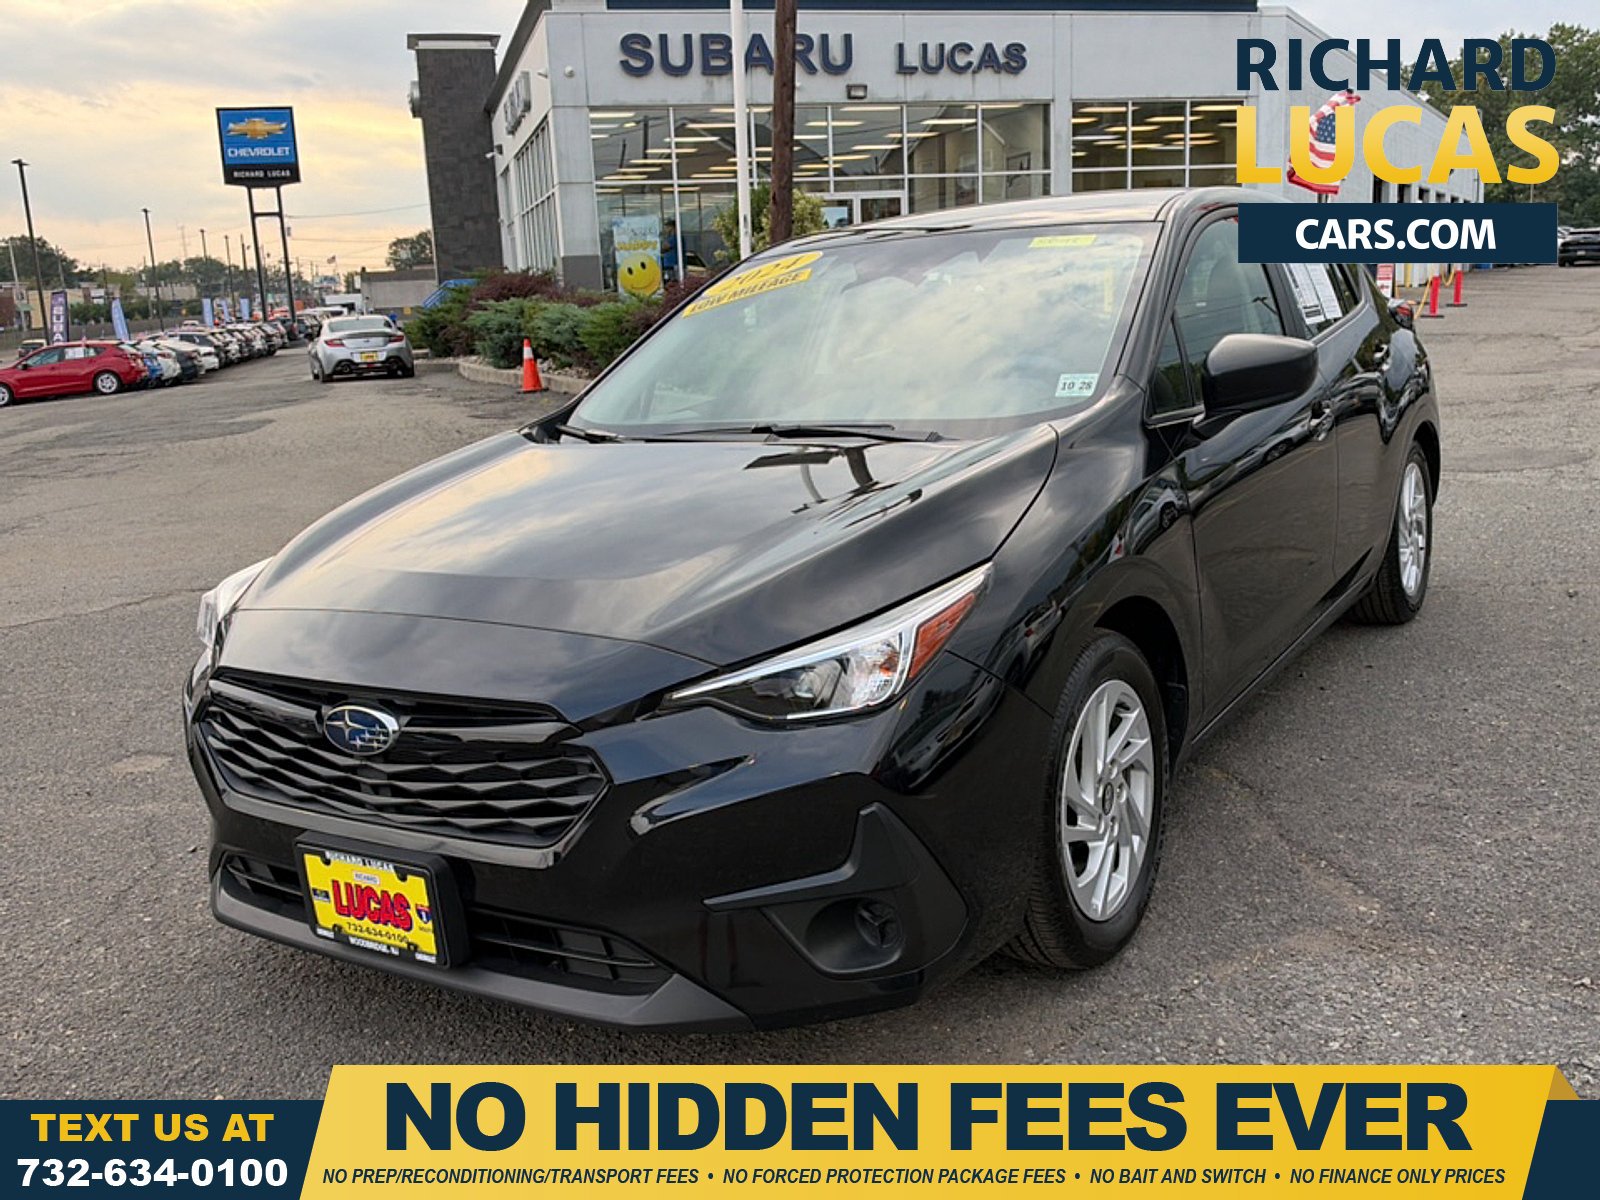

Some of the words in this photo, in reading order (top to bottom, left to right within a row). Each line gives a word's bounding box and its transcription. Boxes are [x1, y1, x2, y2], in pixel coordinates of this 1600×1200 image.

[619, 33, 853, 77] SUBARU
[896, 42, 1029, 75] LUCAS
[228, 146, 290, 157] CHEVROLET
[233, 170, 265, 178] RICHARD
[267, 169, 291, 177] LUCAS
[728, 273, 799, 301] MILEAGE
[331, 879, 413, 933] LUCAS
[346, 921, 410, 944] 732-634-0100
